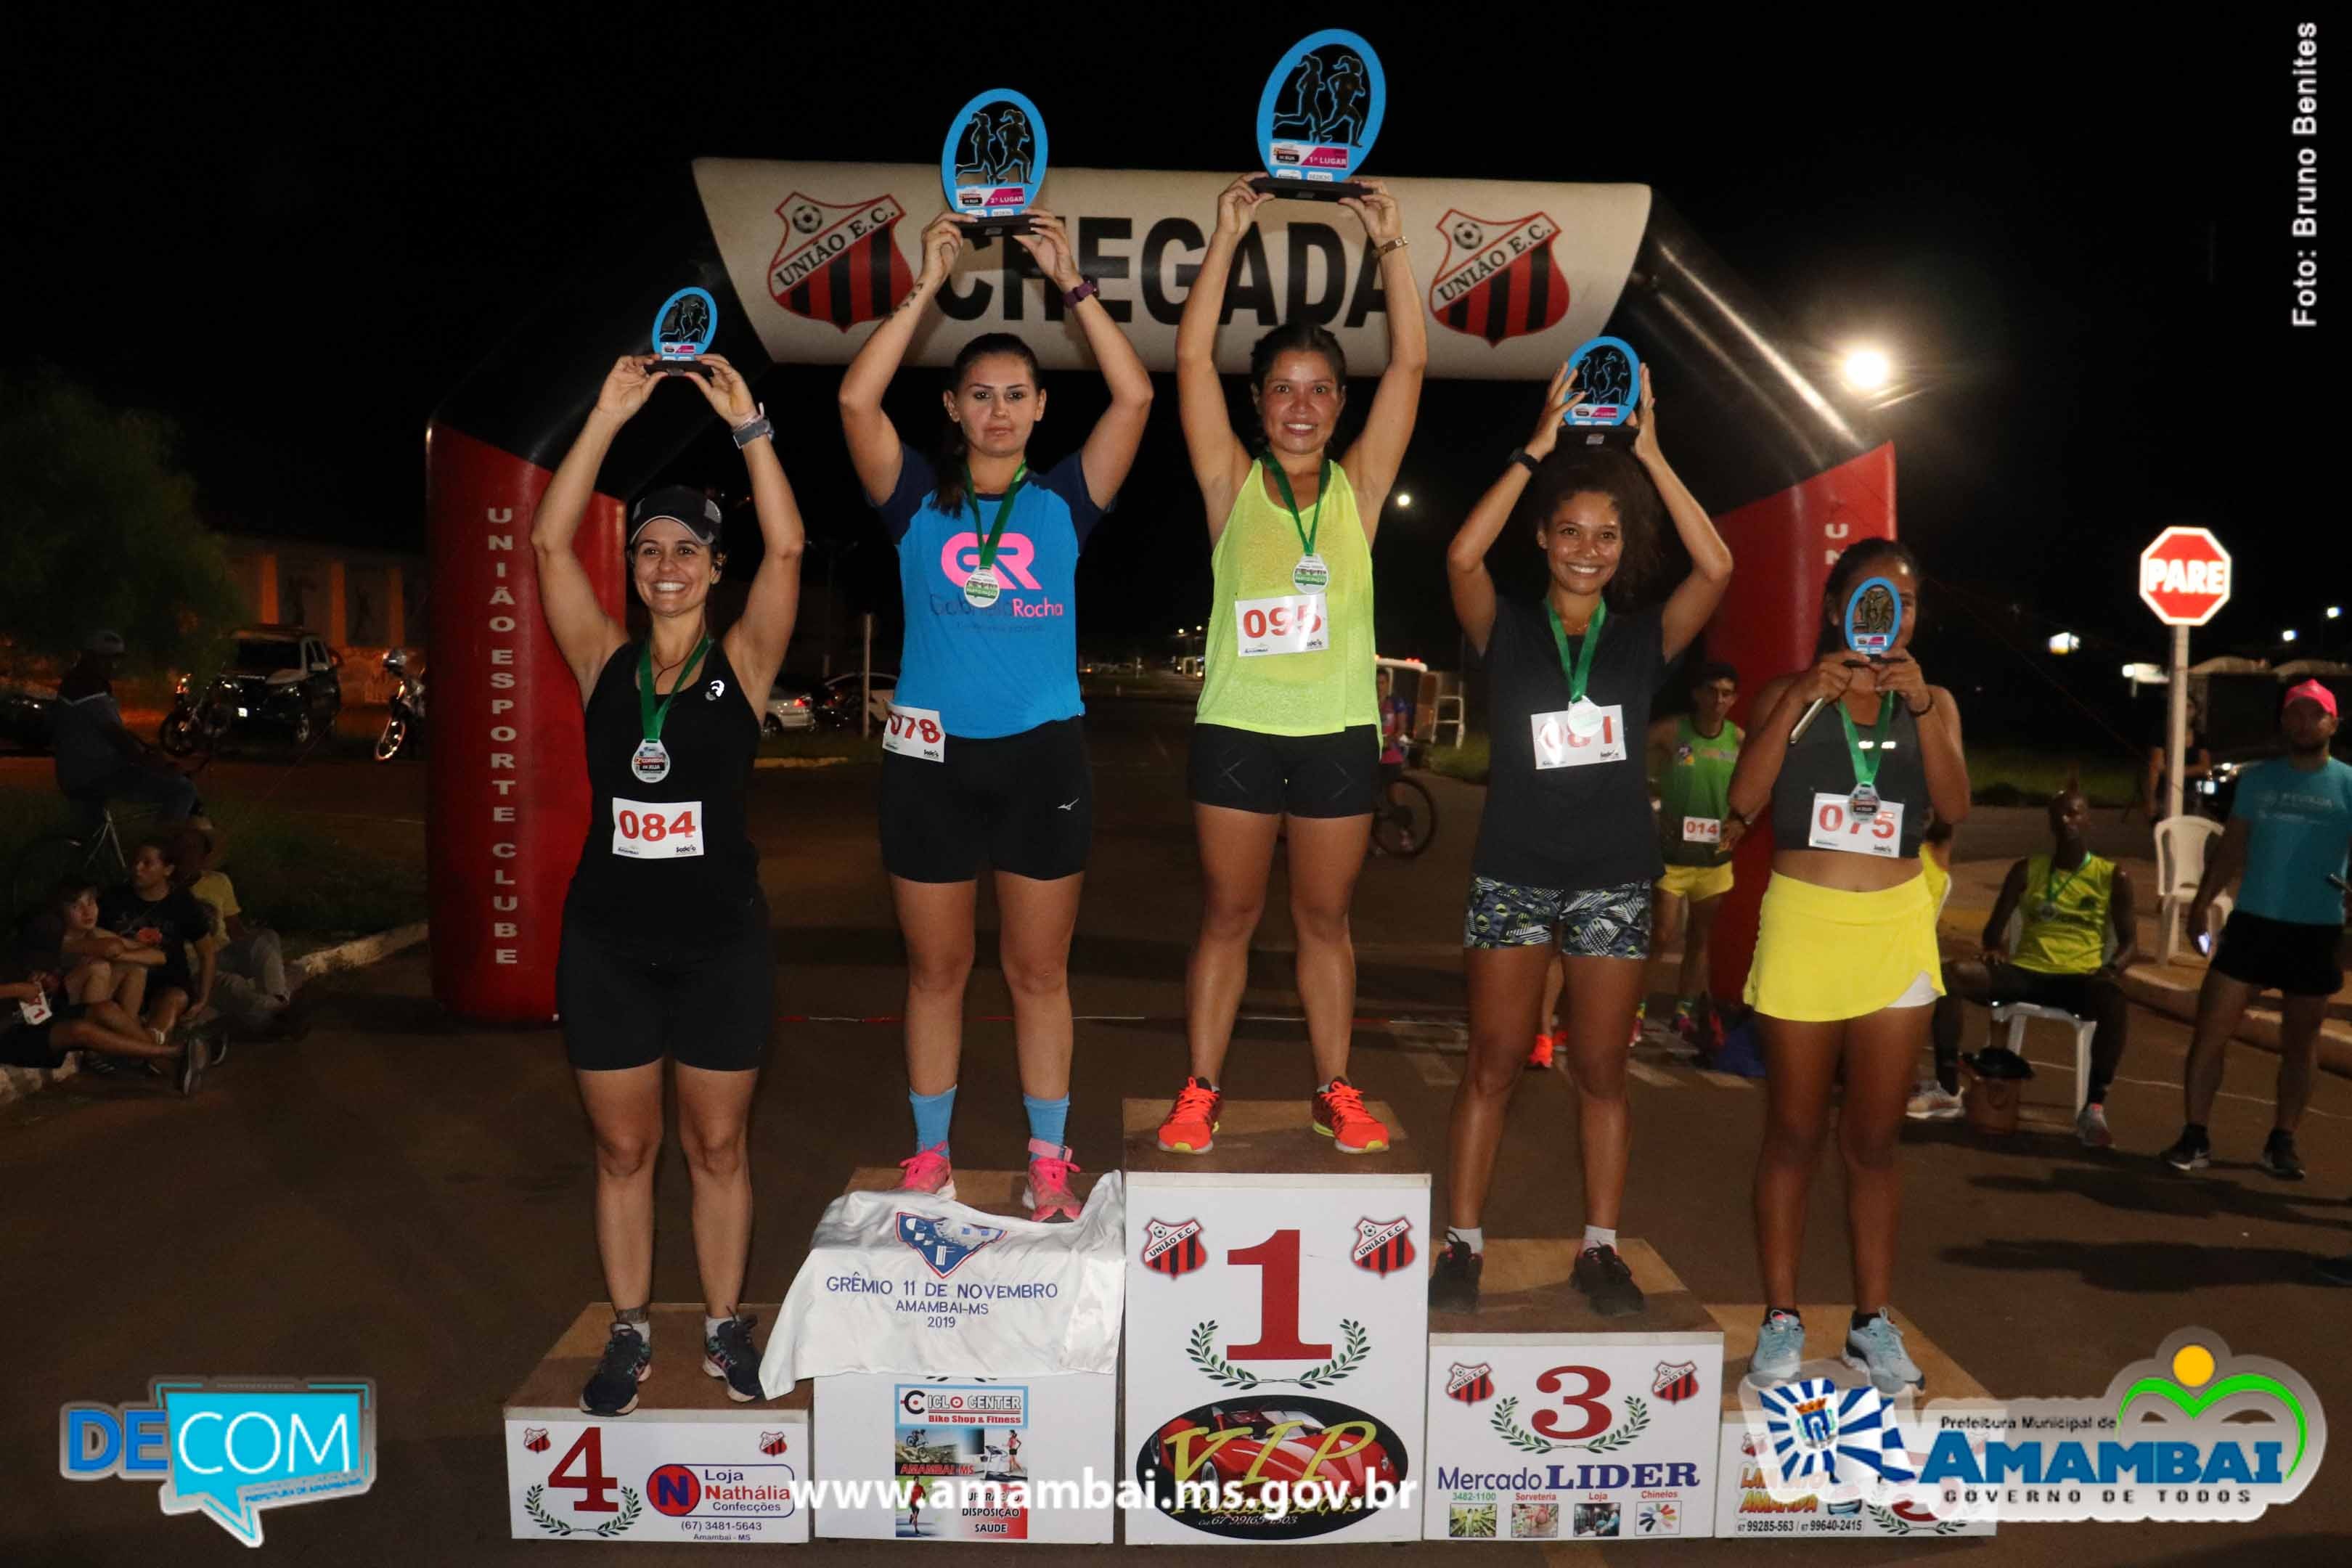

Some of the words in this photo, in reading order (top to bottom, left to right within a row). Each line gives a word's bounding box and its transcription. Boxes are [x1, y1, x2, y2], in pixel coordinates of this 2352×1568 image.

[775, 232, 846, 289] UNIÃO
[849, 206, 897, 240] E.C.
[1437, 250, 1507, 302] UNIÃO
[1510, 223, 1552, 256] E.C.
[488, 508, 515, 632] UNIÃO
[2147, 558, 2225, 595] PARE
[1013, 597, 1063, 618] Rocha
[491, 650, 518, 821] ESPORTE
[889, 711, 941, 743] 078
[619, 809, 696, 841] 084
[1686, 821, 1719, 835] 014
[492, 841, 518, 965] CLUBE
[826, 1272, 892, 1296] GRÊMIO
[903, 1281, 916, 1296] 11
[925, 1283, 947, 1298] DE
[957, 1283, 1058, 1299] NOVEMBRO
[1226, 1229, 1333, 1361] 1
[895, 1300, 989, 1315] AMAMBAI-MS
[927, 1316, 956, 1328] 2019
[967, 1395, 1021, 1409] CENTER
[1531, 1365, 1612, 1440] 3
[1164, 1420, 1378, 1486] VIP
[548, 1426, 619, 1513] 4
[705, 1469, 744, 1484] Loja
[1438, 1466, 1542, 1490] Mercado
[1545, 1462, 1701, 1490] LIDER
[658, 1474, 689, 1506] N
[705, 1485, 791, 1500] Nathália
[1453, 1492, 1497, 1501] 3482-1100
[1515, 1492, 1557, 1501] Sorveteria
[1588, 1492, 1608, 1501] Loja
[1641, 1490, 1678, 1500] Chinelos
[713, 1501, 781, 1514] Confecções
[681, 1521, 702, 1531] (67)
[705, 1522, 762, 1530] 3481-5643
[975, 1522, 1007, 1532] SAÚDE
[1211, 1515, 1225, 1524] 67
[1747, 1520, 1794, 1532] 99285-563
[1810, 1519, 1862, 1532] 99640-2415
